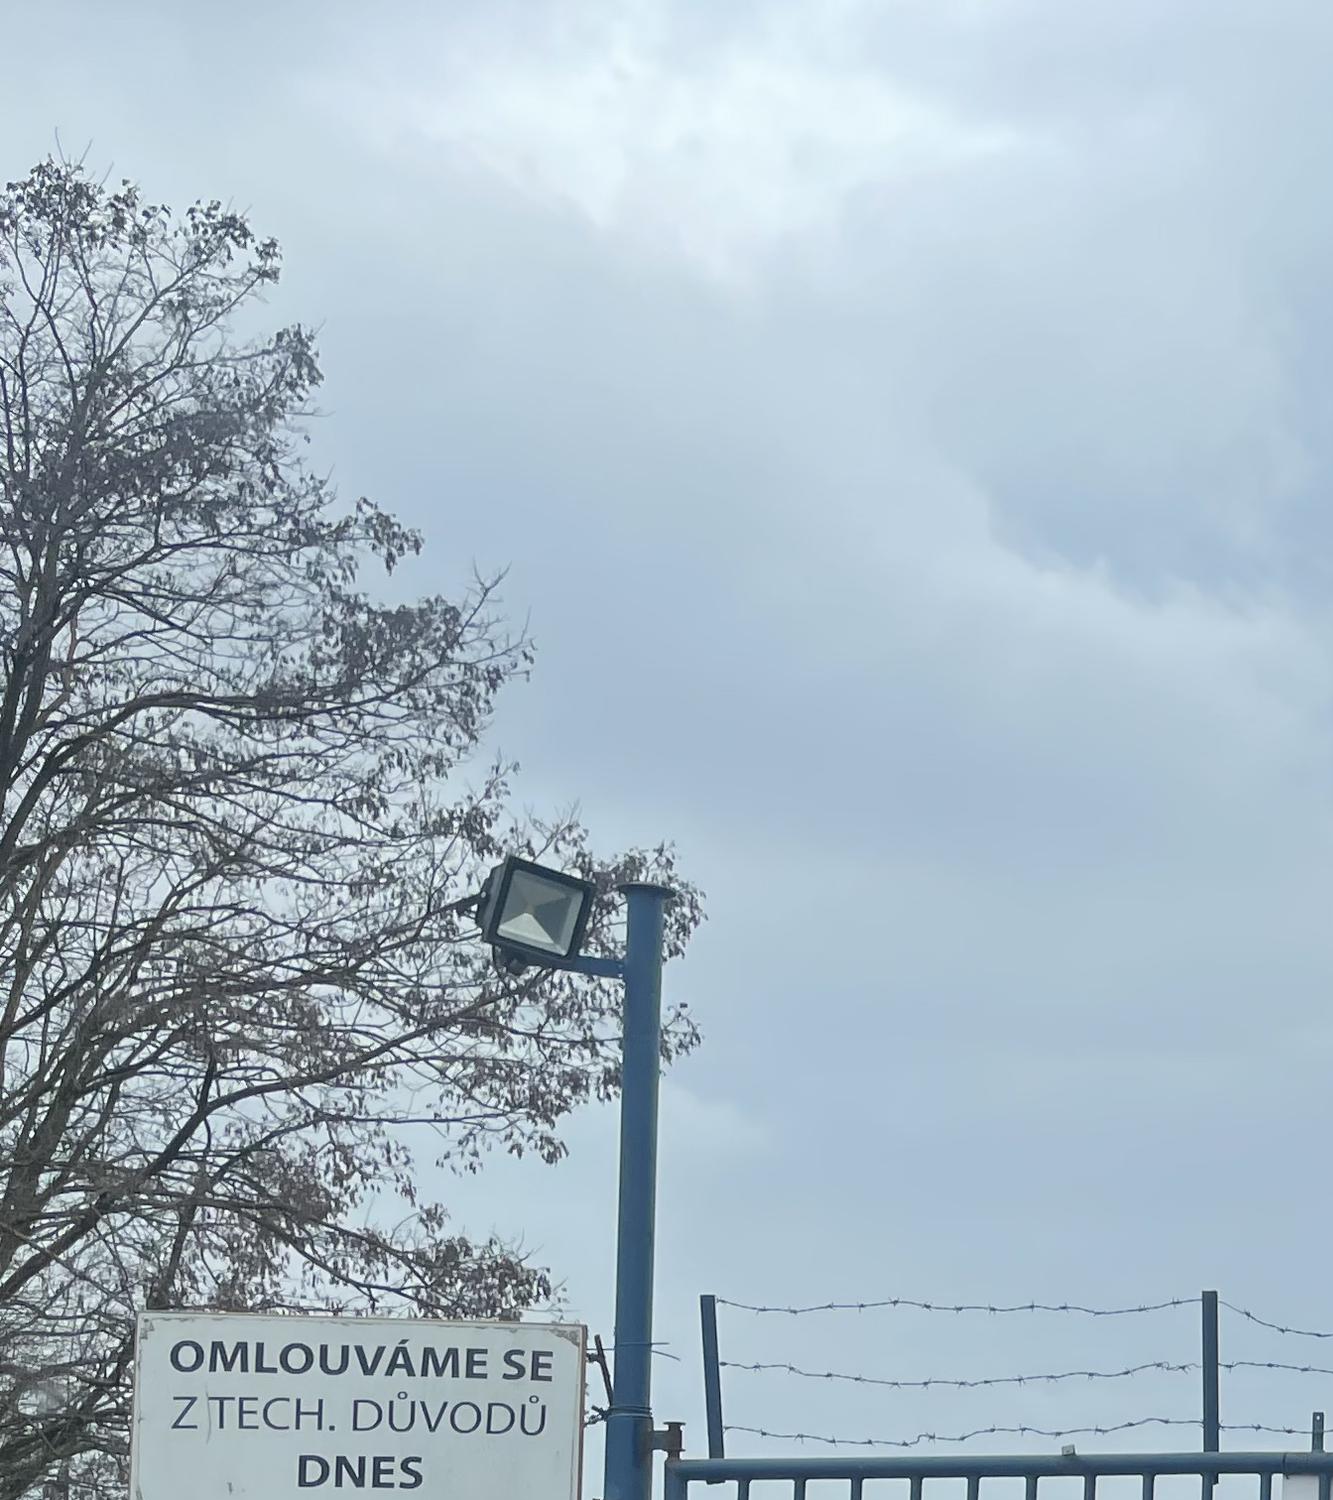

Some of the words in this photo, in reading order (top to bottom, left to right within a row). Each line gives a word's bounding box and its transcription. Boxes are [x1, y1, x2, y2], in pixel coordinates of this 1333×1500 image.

[170, 1339, 489, 1380] OMLOUVÁME
[502, 1349, 554, 1382] SE
[171, 1396, 198, 1429] Z
[208, 1396, 336, 1431] TECH.
[351, 1391, 547, 1436] DŮVODŮ
[297, 1455, 423, 1489] DNES
